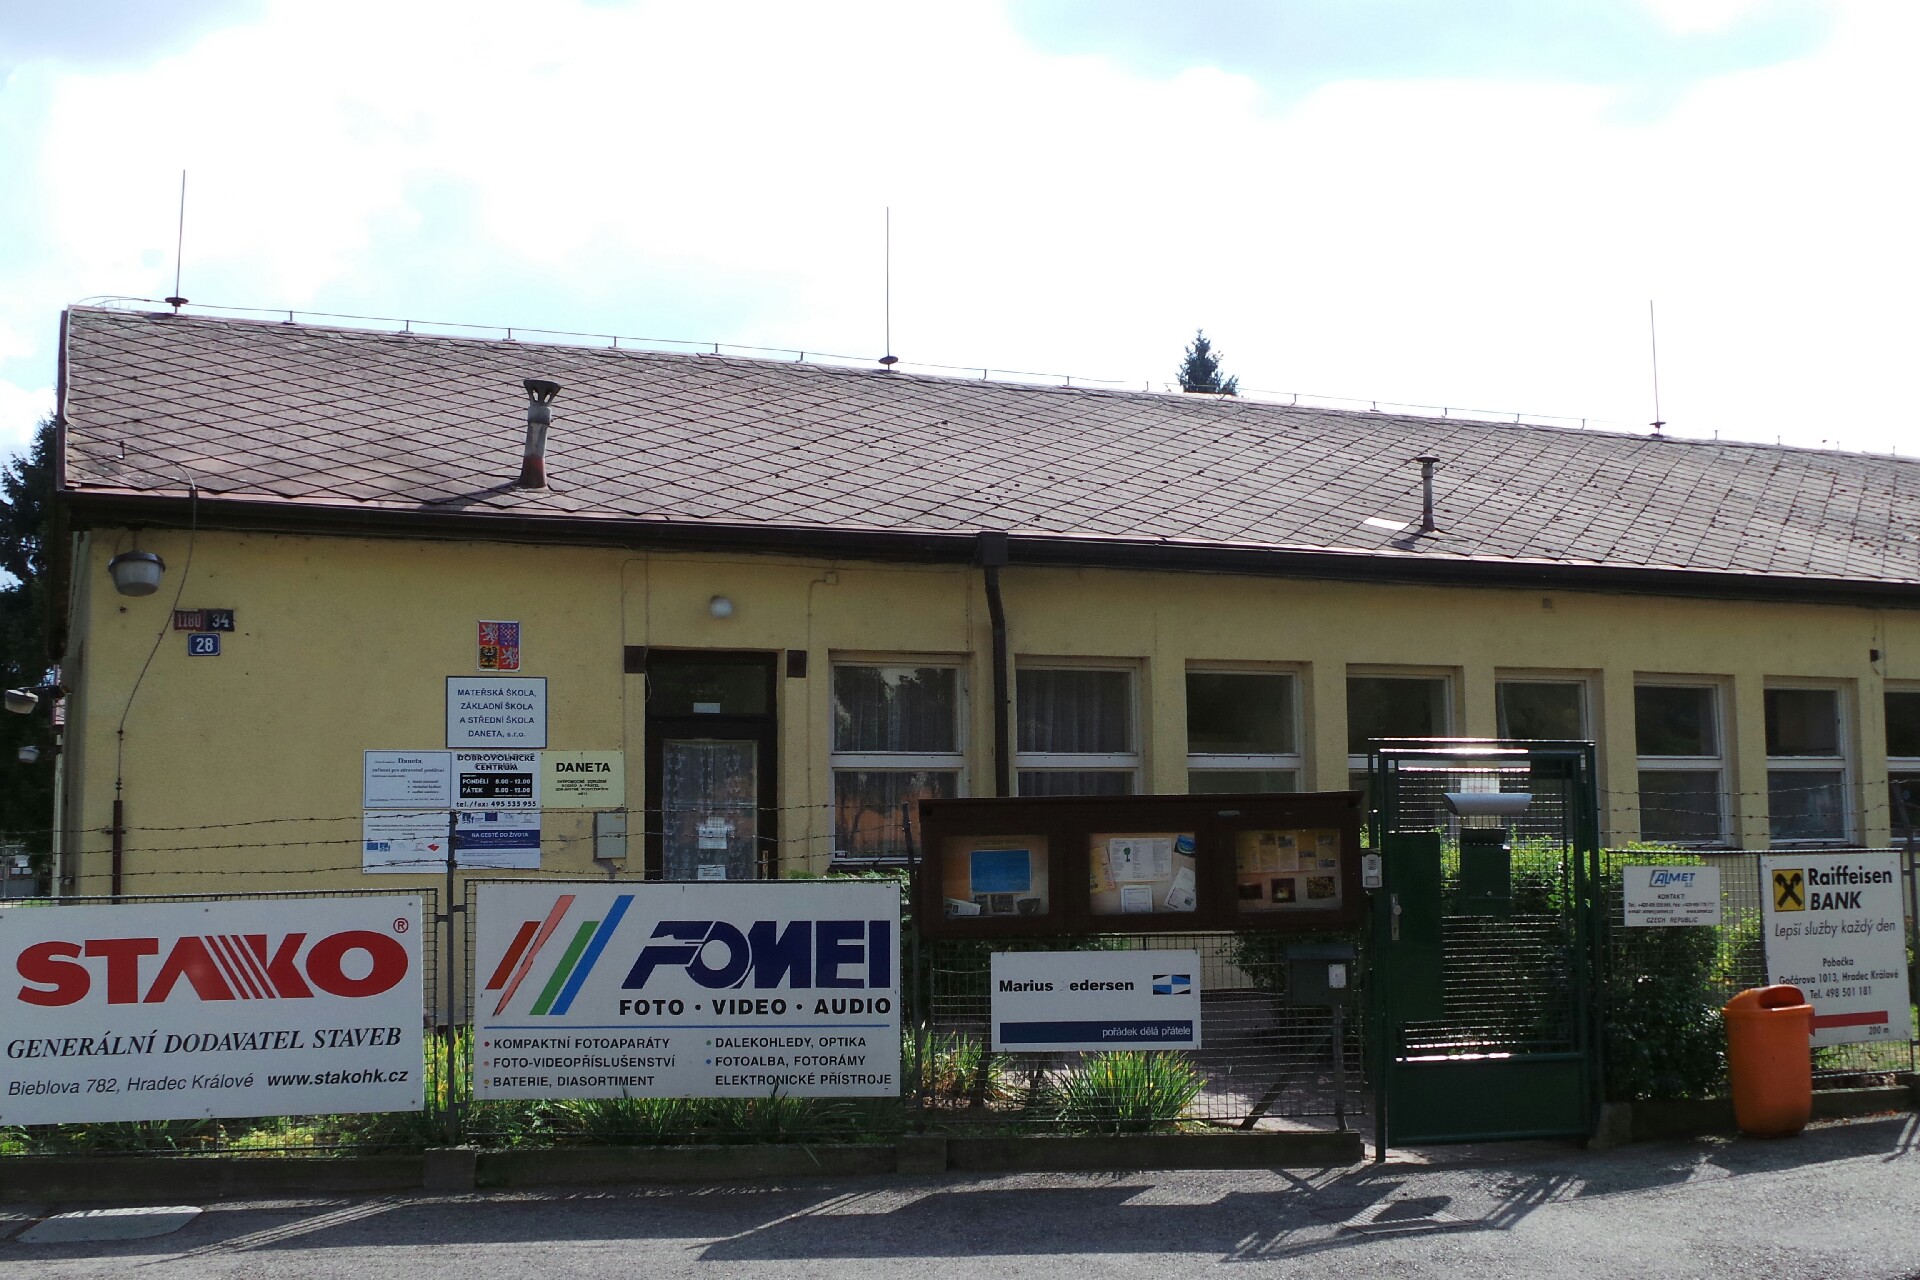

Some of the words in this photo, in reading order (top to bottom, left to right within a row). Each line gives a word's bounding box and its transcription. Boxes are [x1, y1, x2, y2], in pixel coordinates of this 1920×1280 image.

[212, 613, 229, 627] 34
[196, 638, 214, 652] 28
[457, 688, 504, 696] MATEŘSKÁ
[506, 688, 537, 697] ŠKOLA,
[460, 702, 503, 710] ZÁKLADNÍ
[505, 702, 534, 710] ŠKOLA
[468, 715, 504, 724] STŘEDNÍ
[506, 716, 535, 724] ŠKOLA
[468, 730, 505, 738] DANETA,
[556, 763, 611, 772] DANETA
[1808, 866, 1892, 885] Raiffeisen
[1810, 891, 1862, 910] BANK
[1775, 922, 1801, 940] Lepší
[1805, 920, 1838, 938] služby
[1841, 918, 1873, 936] každý
[1877, 918, 1895, 932] den
[621, 920, 891, 989] FOMEI
[16, 930, 409, 1007] STAKO
[1822, 957, 1854, 967] Pobočka
[1779, 975, 1816, 986] Gočárova
[1818, 973, 1840, 984] 1013,
[1842, 971, 1868, 981] Hradec
[1871, 970, 1898, 980] Králové
[999, 979, 1054, 992] Marius
[1810, 989, 1823, 999] Tel.
[1825, 988, 1840, 998] 498
[1842, 988, 1855, 998] 501
[1859, 986, 1872, 996] 181
[619, 999, 685, 1016] FOTO
[712, 999, 787, 1016] VIDEO
[814, 998, 891, 1015] AUDIO
[1102, 1026, 1137, 1038] pořádek
[1139, 1026, 1159, 1036] dělá
[1161, 1026, 1191, 1037] přátele
[1869, 1027, 1882, 1035] 200
[7, 1029, 158, 1059] GENERÁLNÍ
[163, 1031, 305, 1054] DODAVATEL
[312, 1027, 402, 1049] STAVEB
[493, 1035, 571, 1050] KOMPAKTNÍ
[574, 1036, 670, 1049] FOTOAPARÁTY
[715, 1036, 815, 1050] DALEKOHLEDY,
[819, 1036, 866, 1048] OPTIKA
[493, 1053, 675, 1069] FOTO-VIDEOPŘÍSLUŠENSTVÍ
[715, 1055, 789, 1068] FOTOALBA,
[793, 1053, 866, 1067] FOTORÁMY
[8, 1079, 80, 1096] Bieblova
[86, 1078, 121, 1096] 782,
[127, 1075, 187, 1092] Hradec
[191, 1073, 254, 1090] Králové
[267, 1069, 409, 1088] www.stakohk.cz
[493, 1076, 552, 1089] BATERIE,
[558, 1075, 654, 1087] DIASORTIMENT
[715, 1071, 815, 1086] ELEKTRONICKÉ
[819, 1071, 892, 1086] PŘÍSTROJE
